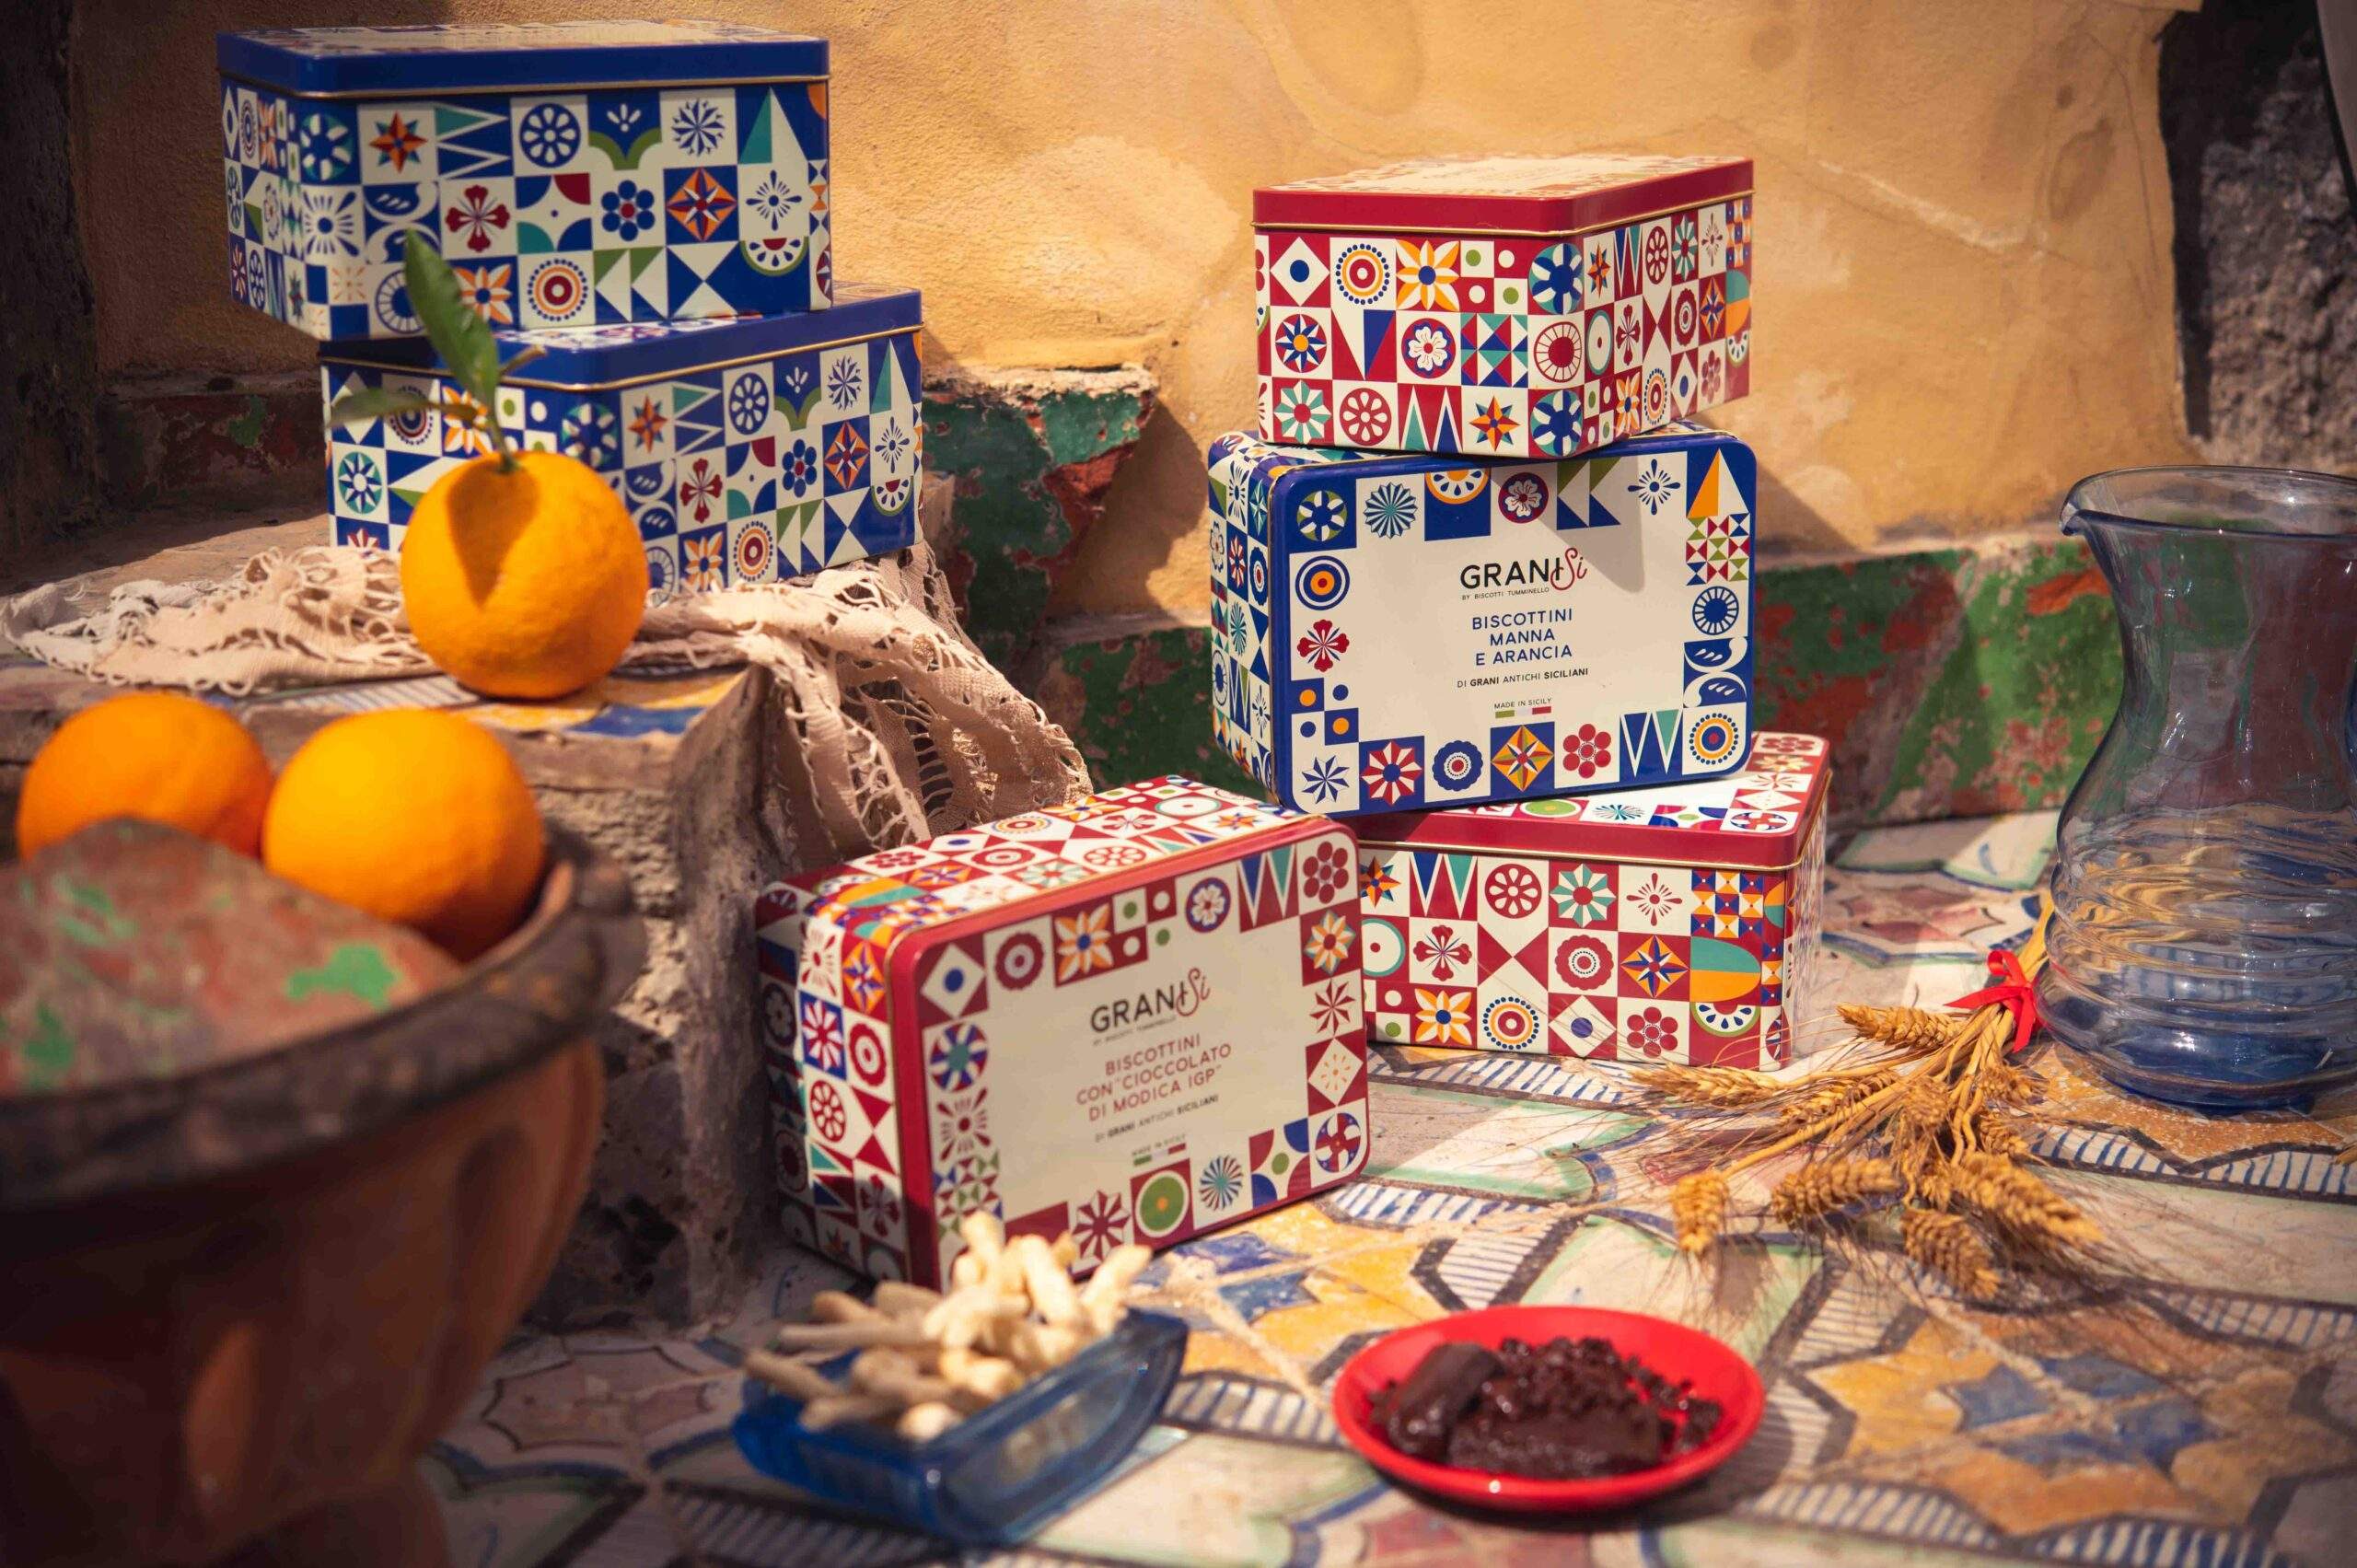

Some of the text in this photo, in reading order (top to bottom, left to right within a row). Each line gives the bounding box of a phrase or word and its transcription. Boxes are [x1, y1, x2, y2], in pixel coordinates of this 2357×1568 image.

[1508, 587, 1550, 597] TUMMINELLO
[1472, 609, 1573, 630] BISCOTTINI
[1490, 629, 1555, 646] MANNA
[1476, 645, 1572, 666] E ARANCIA
[1470, 678, 1499, 687] GRANI
[1503, 673, 1540, 683] ANTICHI
[1544, 668, 1588, 679] SICILIANI
[1106, 1033, 1200, 1075] BISCOTTINI
[1076, 1085, 1112, 1105] CON
[1089, 1105, 1106, 1121] DI
[1113, 1081, 1180, 1113] MODICA
[1108, 1121, 1135, 1137] GRANI
[1177, 1095, 1218, 1114] SICILIANI
